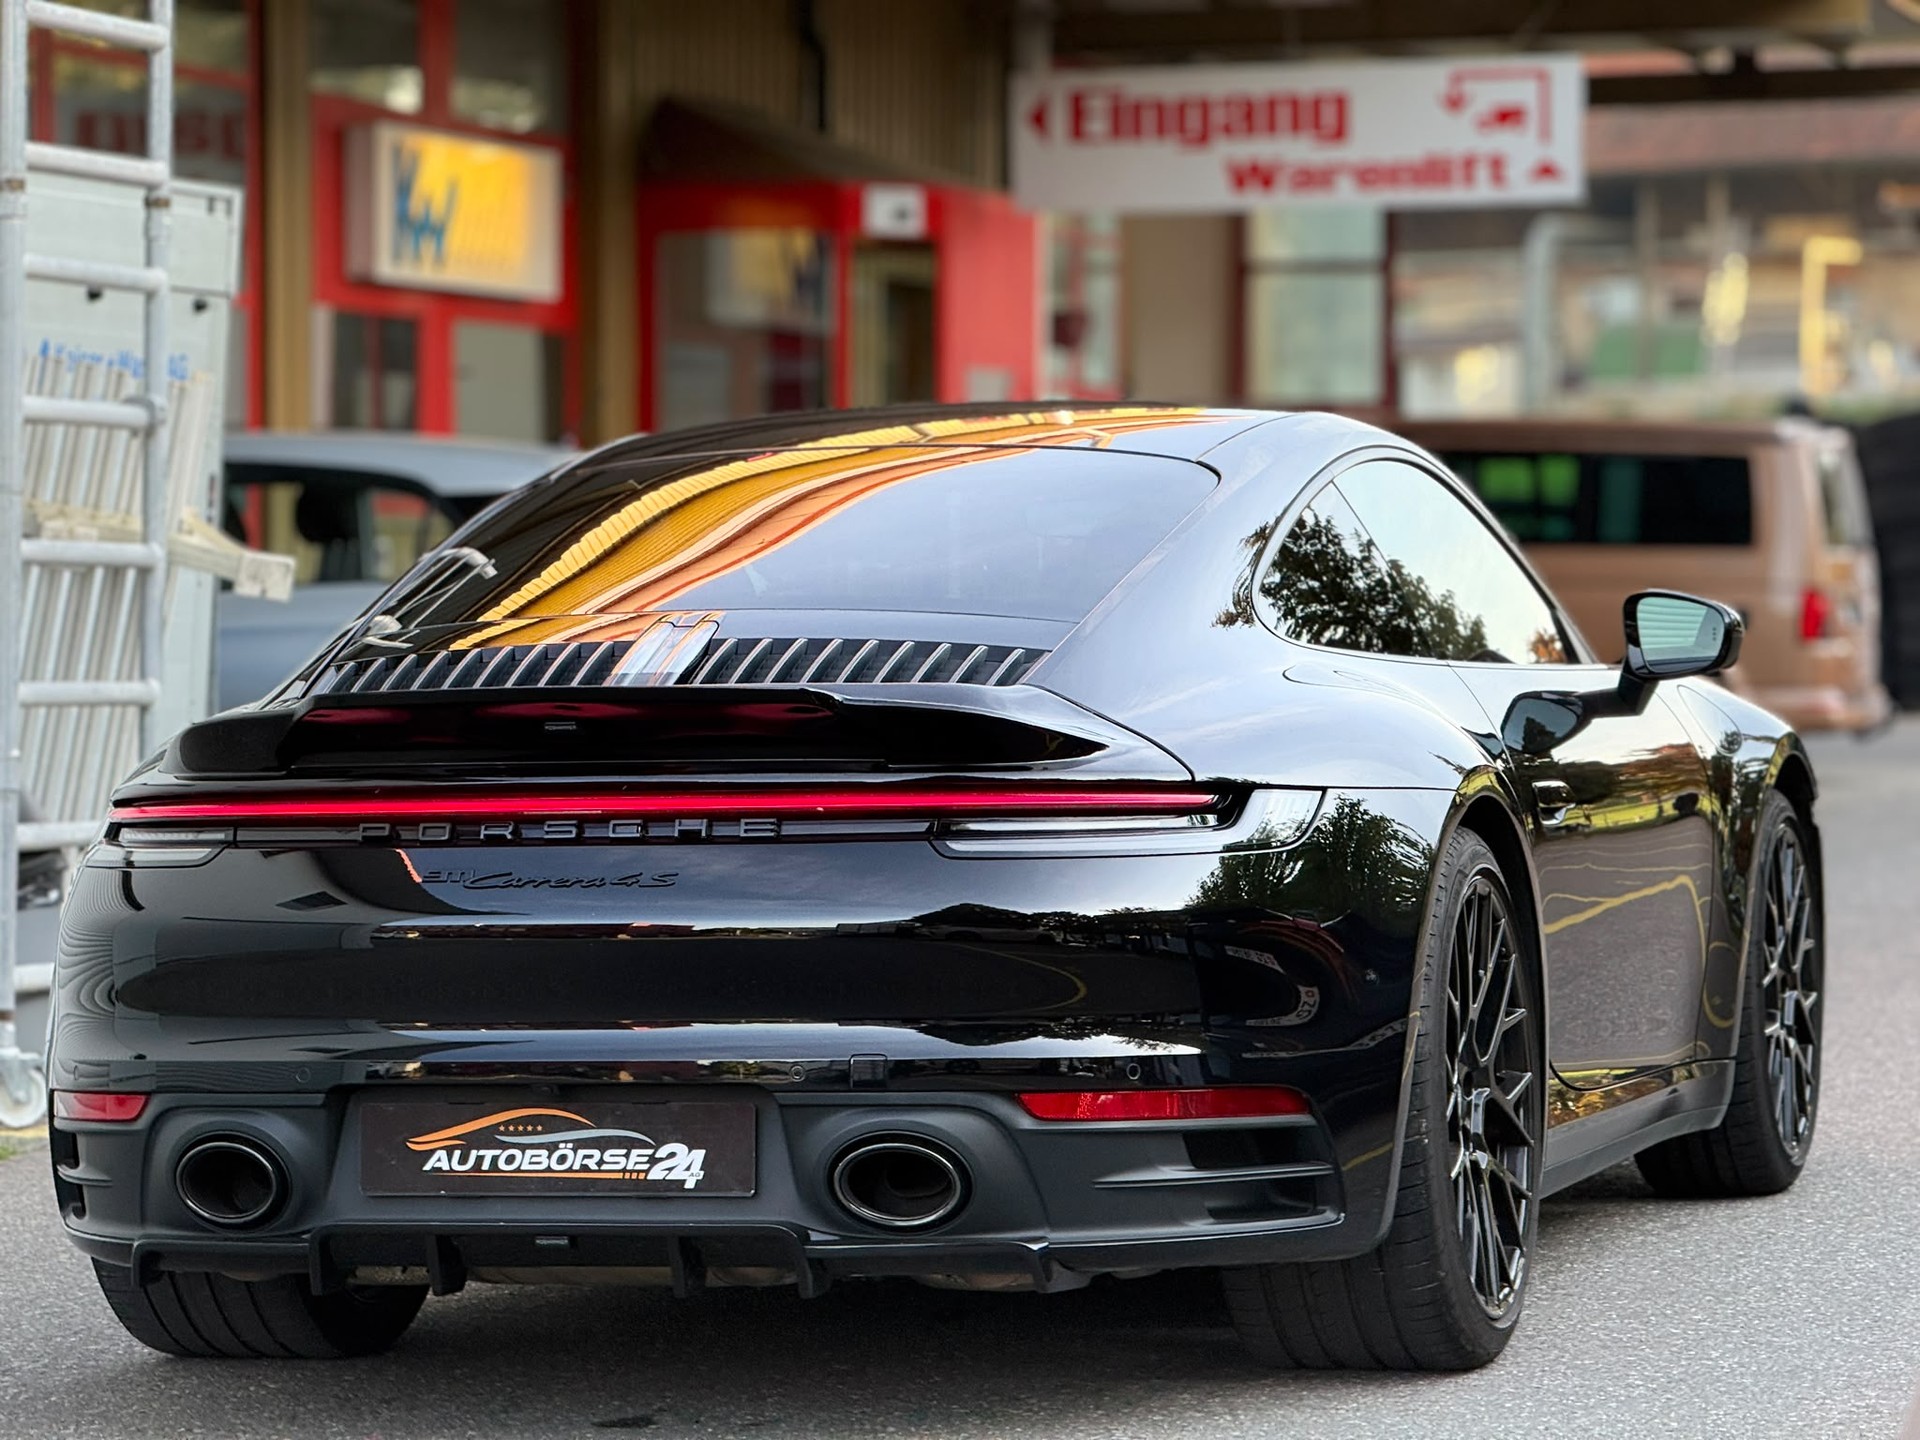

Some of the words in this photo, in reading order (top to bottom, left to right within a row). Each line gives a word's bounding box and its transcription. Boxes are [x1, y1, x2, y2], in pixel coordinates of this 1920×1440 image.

[1068, 89, 1350, 149] Eingang
[358, 818, 782, 842] PORSCHE
[463, 872, 606, 889] Carrera
